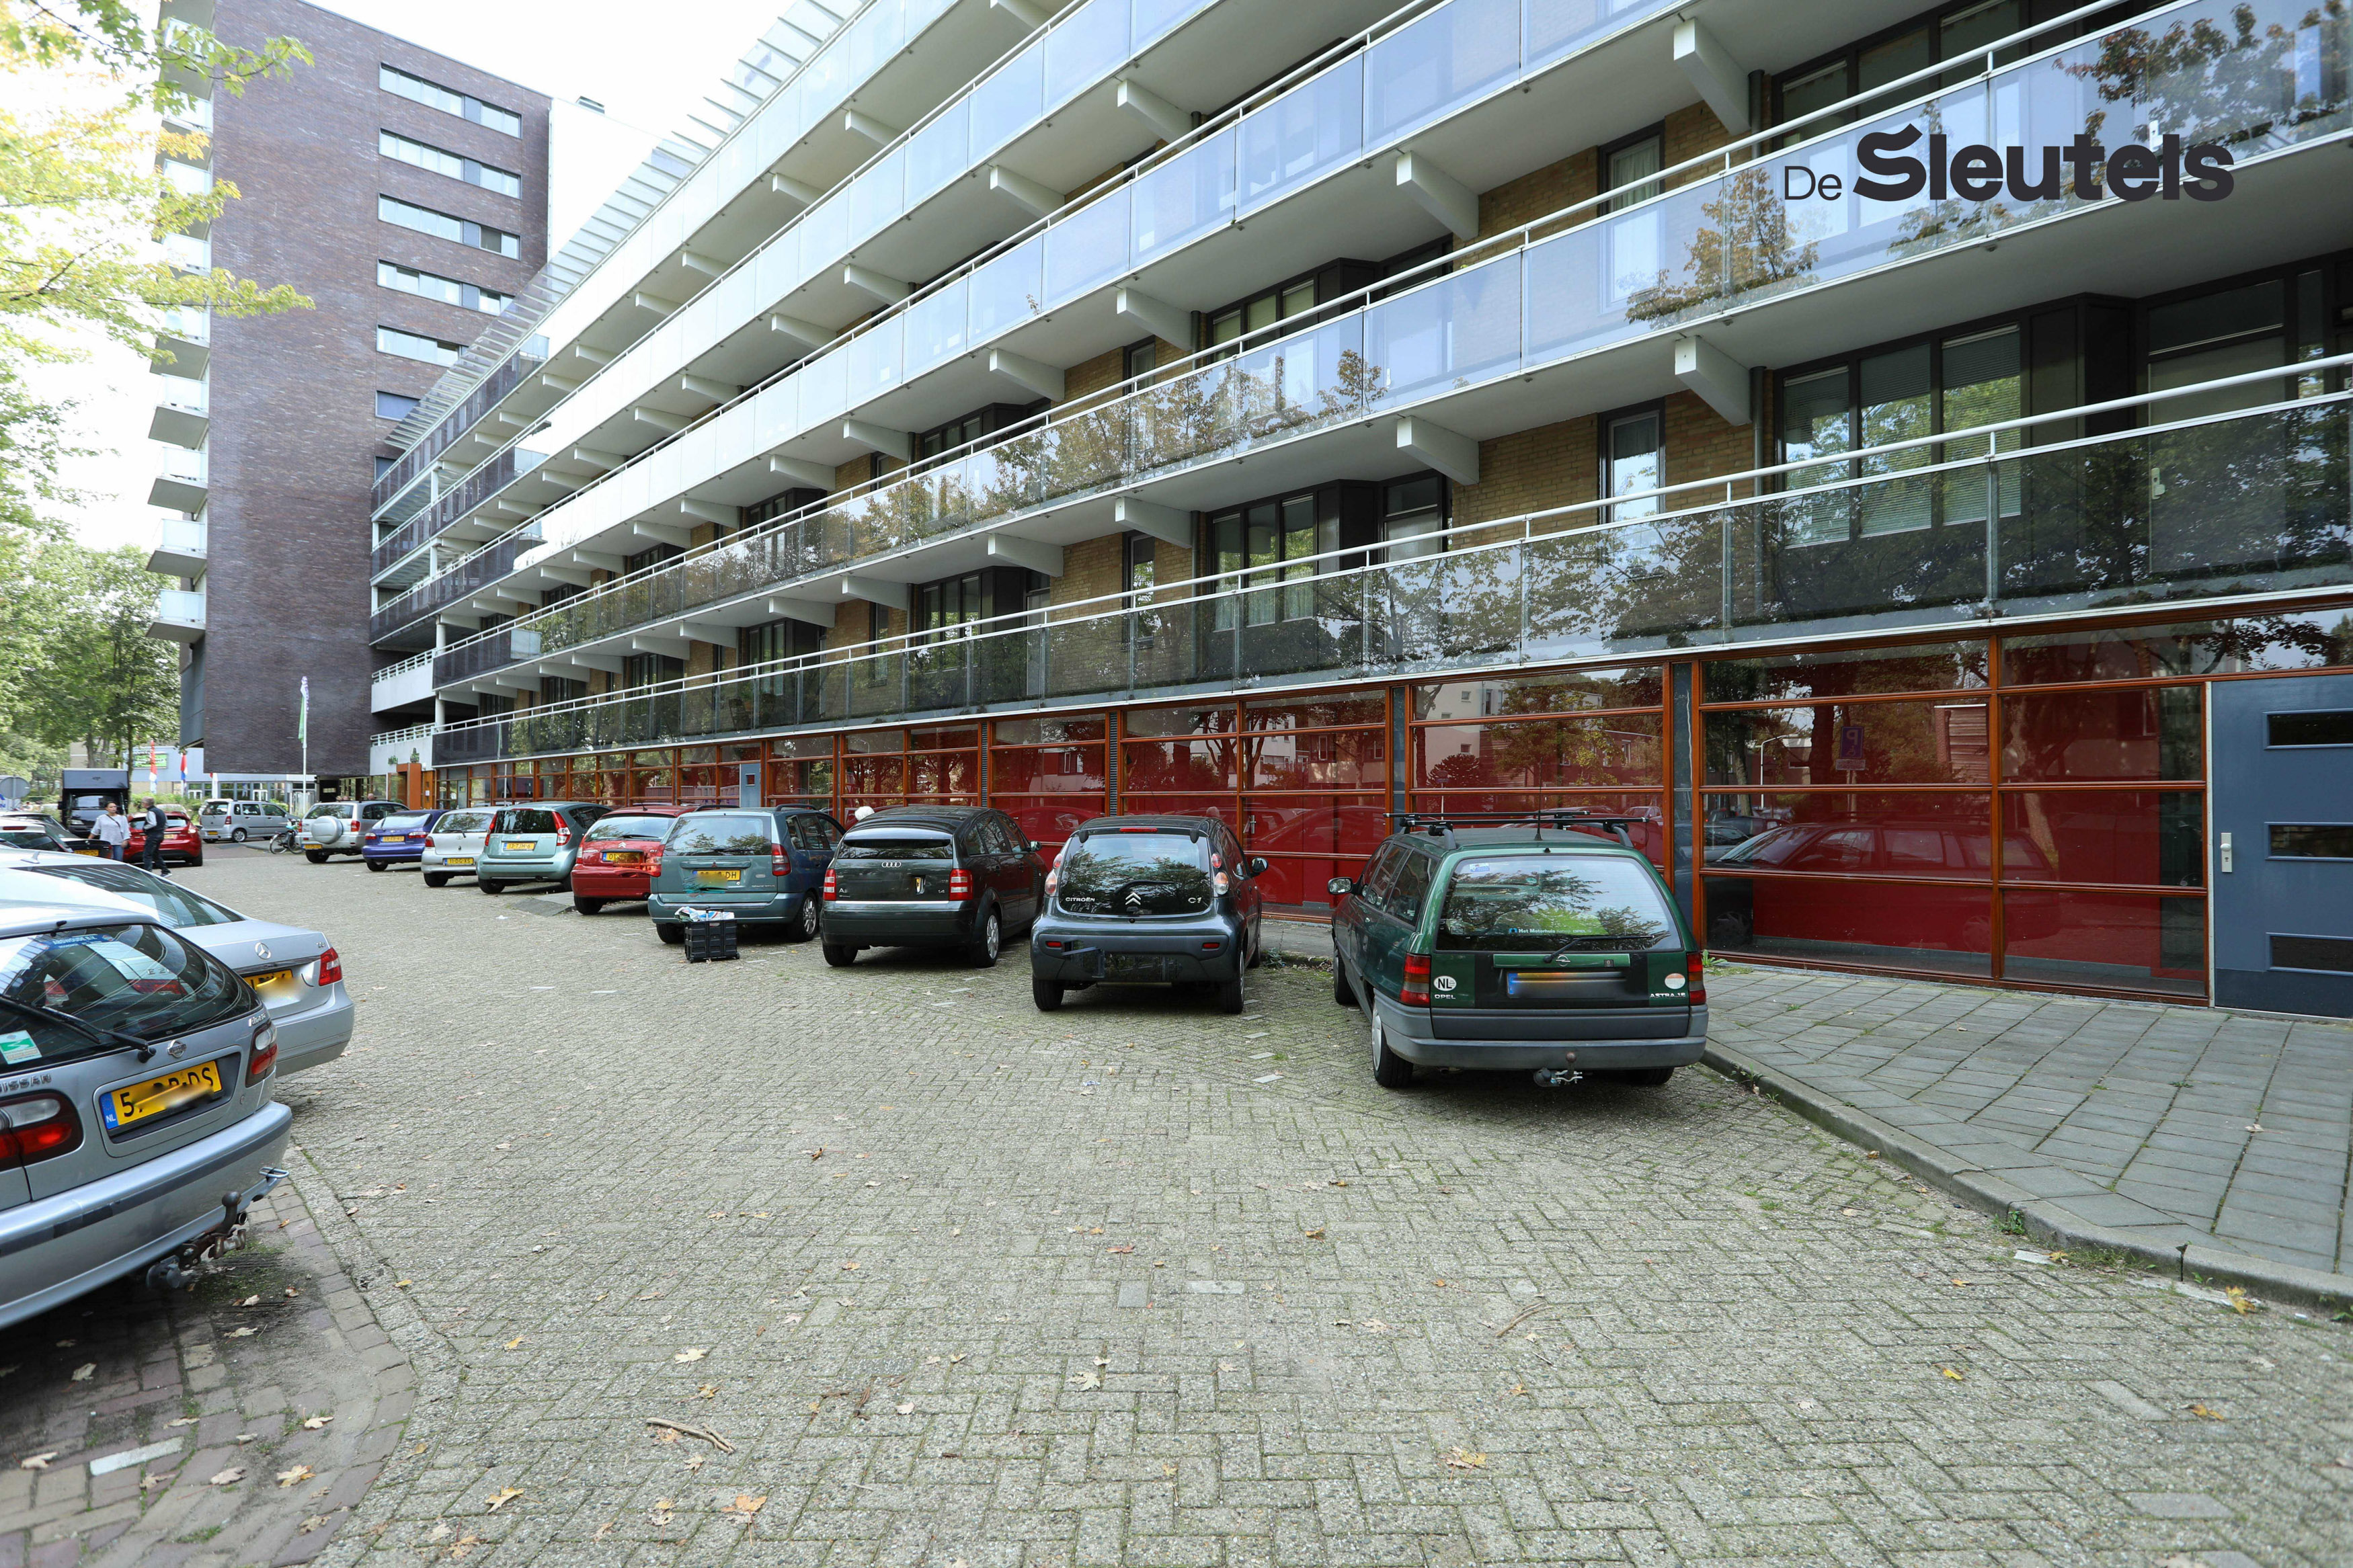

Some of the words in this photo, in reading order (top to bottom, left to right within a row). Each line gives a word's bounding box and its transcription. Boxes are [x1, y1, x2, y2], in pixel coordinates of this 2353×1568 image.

[1438, 978, 1453, 989] NL
[0, 1074, 52, 1093] ISSAN
[106, 1114, 116, 1123] NL
